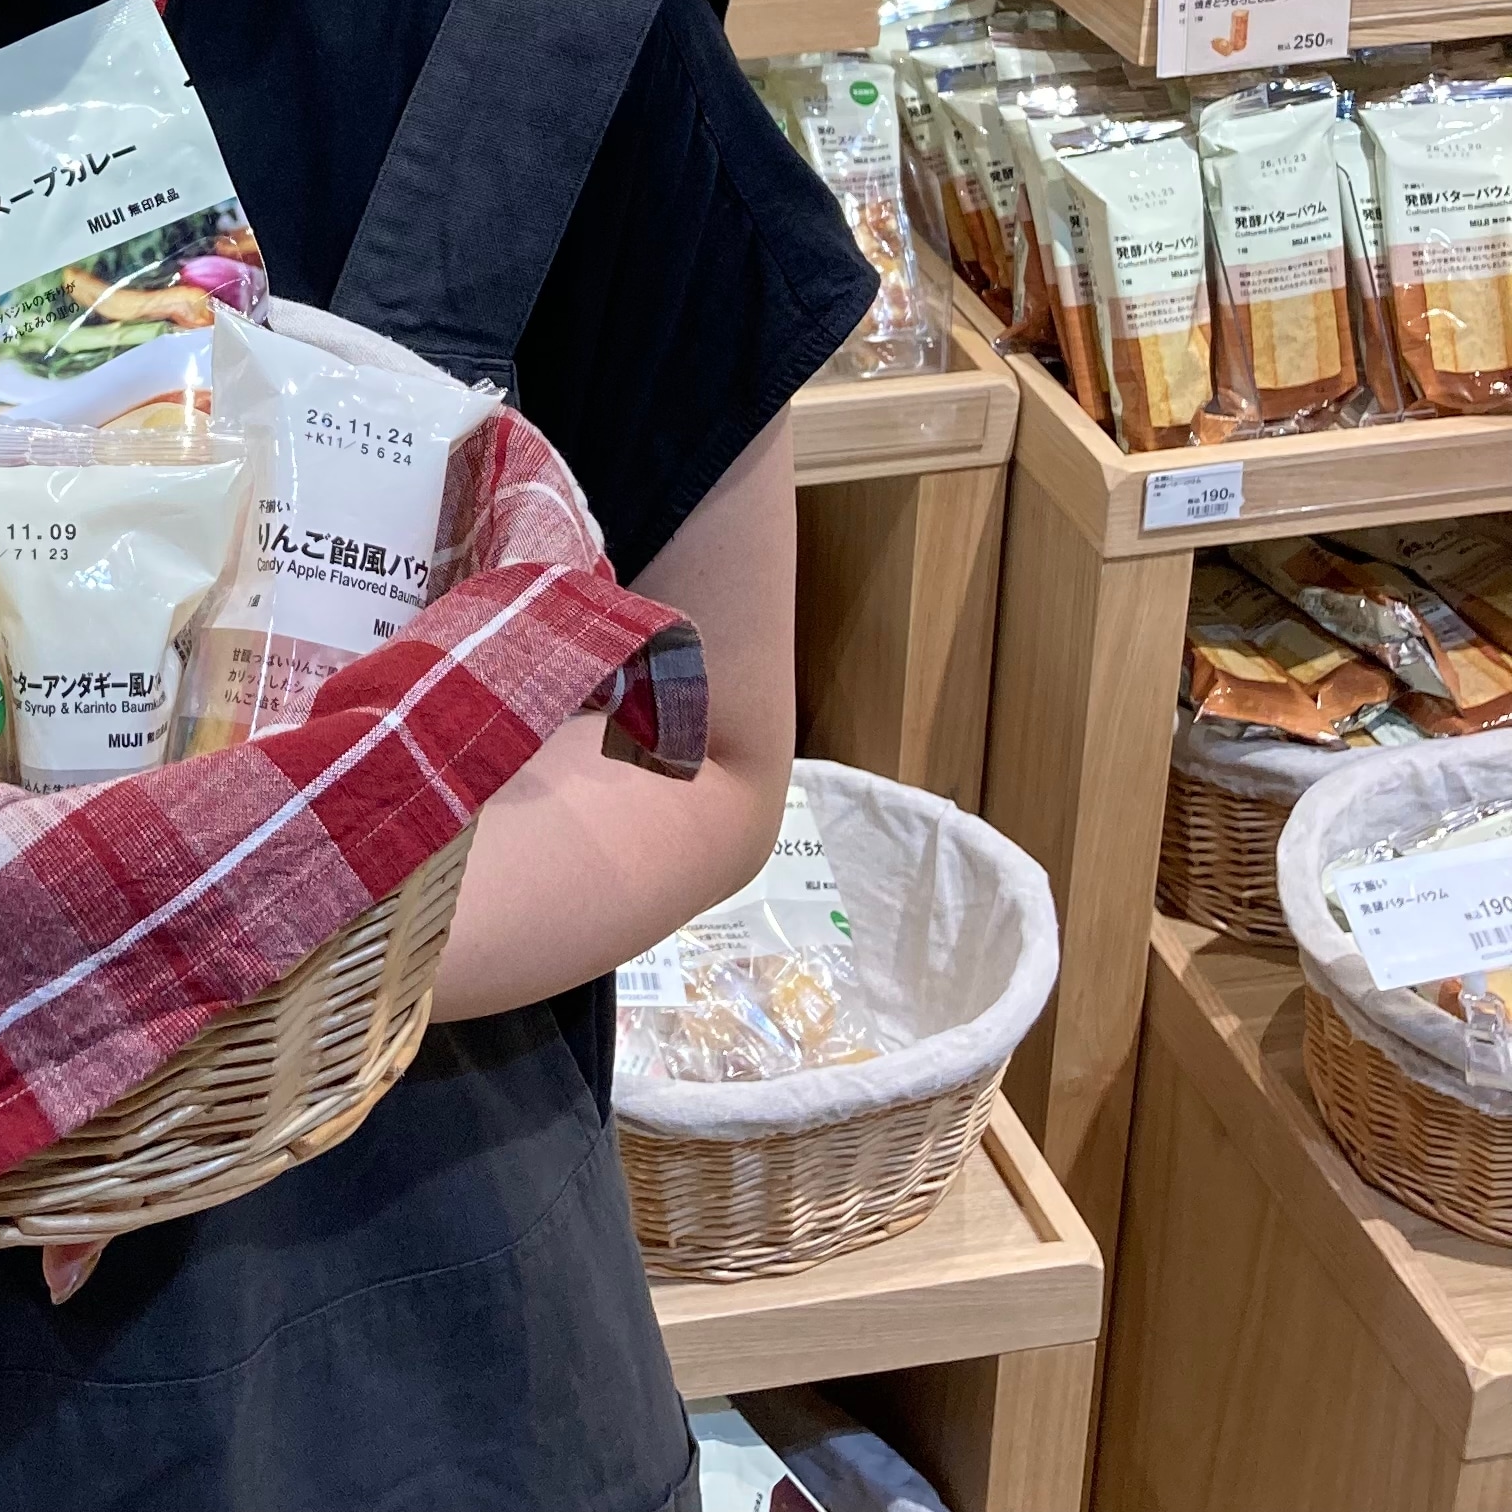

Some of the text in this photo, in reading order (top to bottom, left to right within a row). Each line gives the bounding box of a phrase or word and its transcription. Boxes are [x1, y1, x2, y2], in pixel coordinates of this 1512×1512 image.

[1294, 32, 1333, 49] 250円
[1260, 152, 1307, 170] 26.11.23
[86, 187, 180, 235] MUJI 無印良品
[1235, 200, 1328, 230] 発酵バターバウム
[306, 408, 414, 448] 26.11.24
[259, 499, 290, 514] 不揃い
[258, 523, 431, 589] りんご飴風バウ
[257, 558, 387, 596] Candy Apple Flavored
[25, 700, 56, 717] Syrup
[74, 701, 117, 714] Karinto
[108, 733, 143, 748] MUJI
